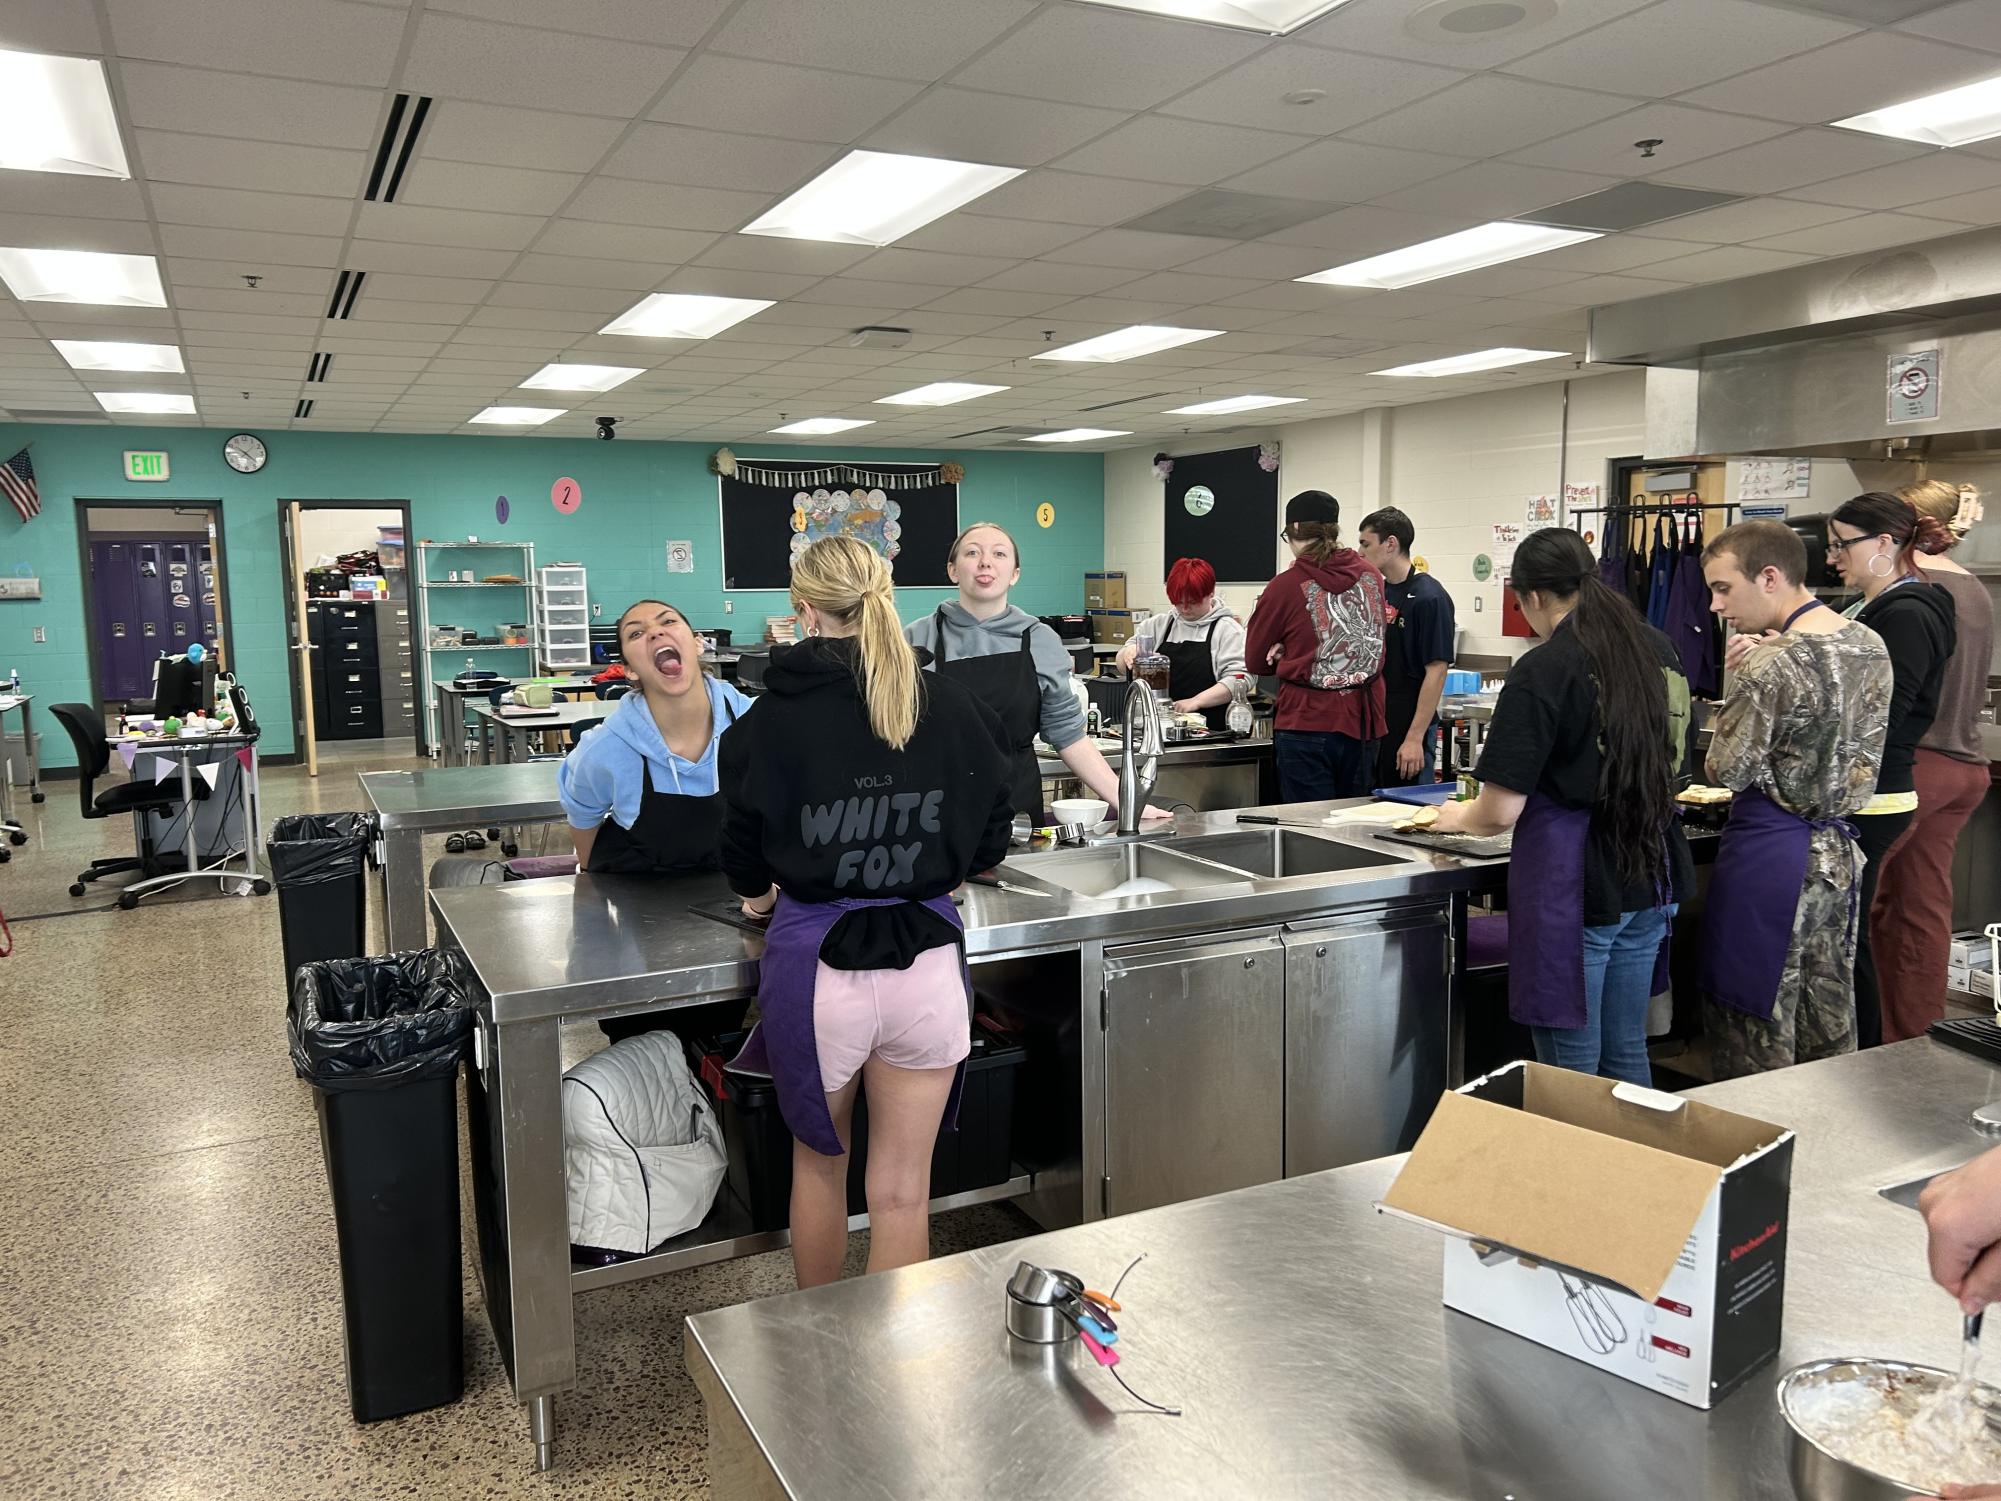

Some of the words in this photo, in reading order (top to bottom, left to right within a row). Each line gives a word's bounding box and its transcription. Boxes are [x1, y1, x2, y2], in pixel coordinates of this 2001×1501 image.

[131, 454, 162, 476] EXIT
[562, 486, 571, 505] 2
[1043, 508, 1049, 522] 5
[854, 774, 893, 790] VOL.3
[800, 789, 945, 849] WHITE
[833, 841, 923, 891] FOX
